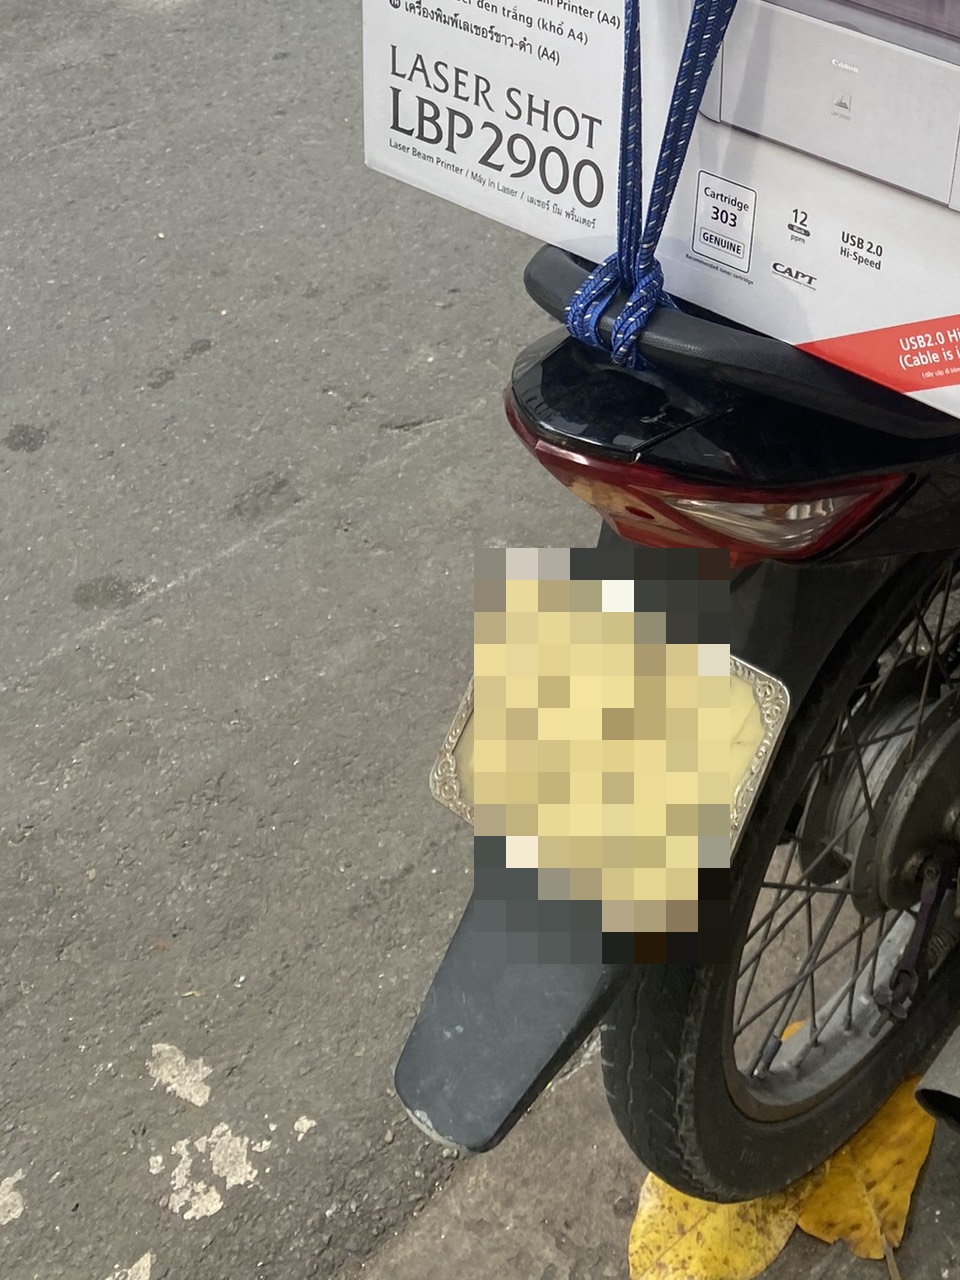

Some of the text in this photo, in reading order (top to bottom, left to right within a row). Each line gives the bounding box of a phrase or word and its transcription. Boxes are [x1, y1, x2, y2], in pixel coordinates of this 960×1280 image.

[502, 6, 533, 28] trắng
[537, 17, 564, 36] (khổ
[567, 28, 588, 46] A4)
[597, 10, 621, 30] (A4)
[537, 45, 561, 67] (A4)
[389, 44, 603, 150] LASER SHOT
[389, 138, 410, 154] Laser
[412, 147, 434, 164] Beam
[436, 156, 464, 175] Printer
[497, 181, 518, 197] Laser
[703, 186, 750, 213] Cartridge
[711, 205, 738, 228] 303
[792, 208, 808, 227] 12
[702, 231, 742, 255] GENUINE
[790, 234, 806, 244] ppm
[841, 231, 883, 257] USB 2.0
[840, 246, 881, 271] Hi-Speed
[772, 262, 817, 286] CAPT
[899, 331, 945, 351] USB2.0
[898, 350, 940, 371] (Cable
[941, 347, 954, 361] is
